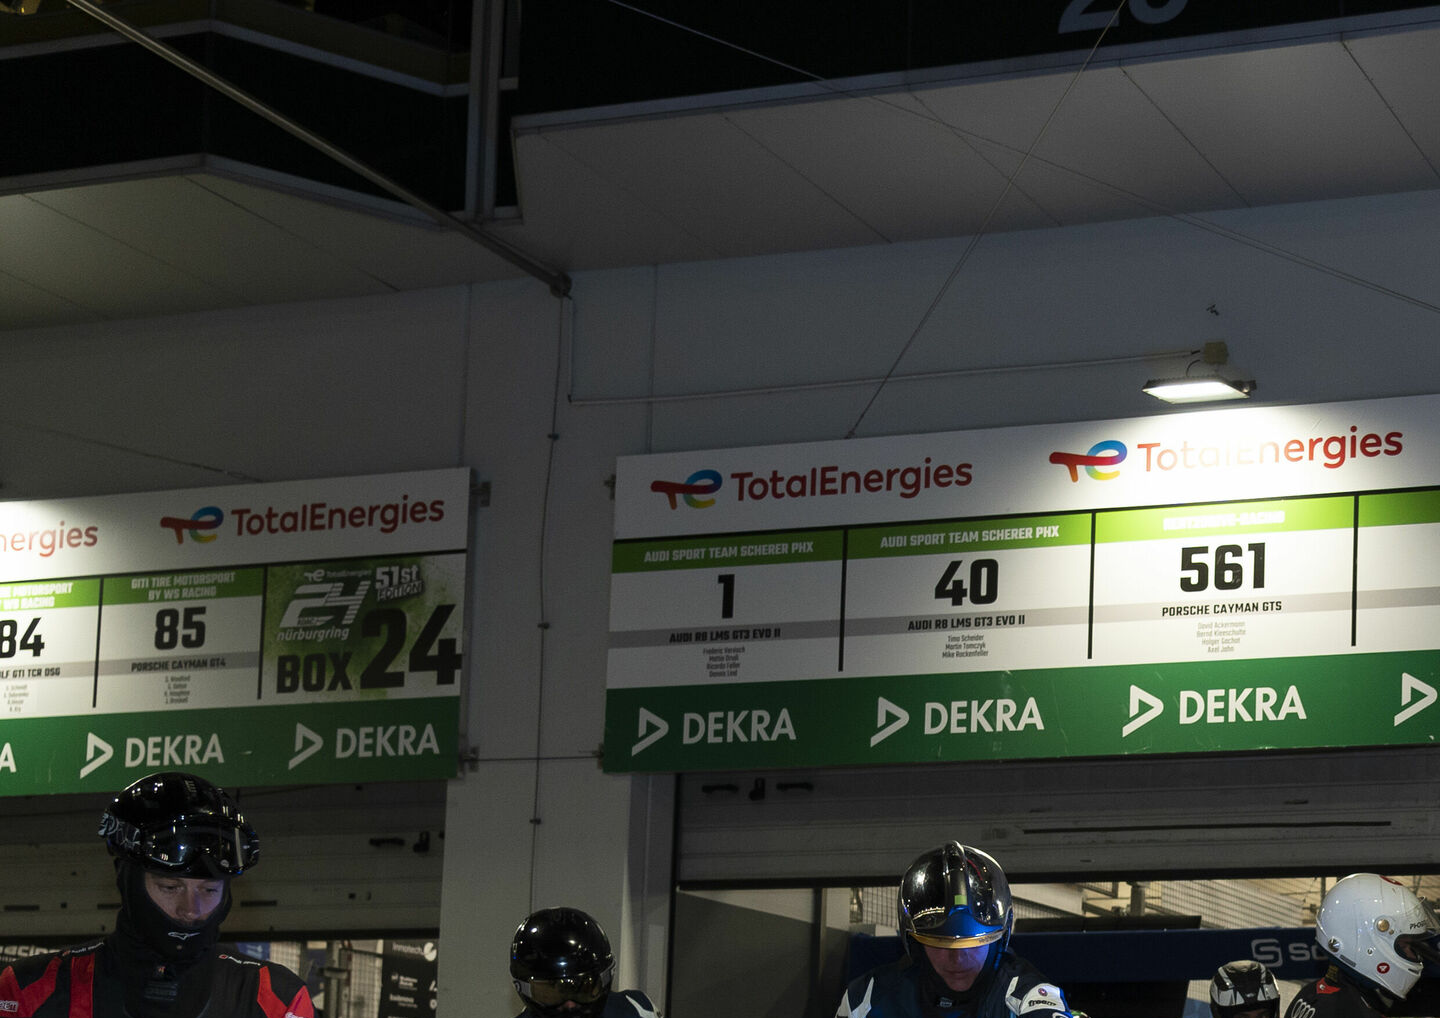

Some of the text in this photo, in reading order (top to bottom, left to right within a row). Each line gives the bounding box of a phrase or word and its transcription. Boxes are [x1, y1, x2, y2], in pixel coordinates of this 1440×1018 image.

[1137, 425, 1404, 473] TotalEnergies
[731, 457, 973, 501] TotalEnergies
[231, 495, 445, 536] TotalEnergies
[643, 541, 814, 563] AUDI SPORT TEAM SCHERER PHX
[880, 525, 1060, 549] AUDI SPORT TEAM SCHERER PHX
[152, 572, 236, 588] TIRE MOTORSPORT
[375, 565, 419, 589] 51st
[934, 559, 999, 607] 40
[1180, 542, 1266, 592] 561
[183, 586, 217, 598] RACING
[718, 574, 735, 619] 1
[1161, 601, 1282, 617] PORSCHE CAYMAN GTS
[0, 617, 45, 659] 84
[154, 606, 207, 650] 85
[276, 626, 350, 643] nürburgring
[669, 632, 692, 643] AUDI
[907, 615, 1015, 631] AUDI R8 LMS GT3 EVO
[131, 658, 226, 672] PORSCHE CAYMAN GT4
[276, 604, 463, 693] BOX 24
[924, 697, 1045, 735] DEKRA
[1179, 685, 1307, 725] DEKRA
[336, 723, 441, 759] DEKRA
[683, 707, 797, 745] DEKRA
[125, 733, 225, 769] DEKRA
